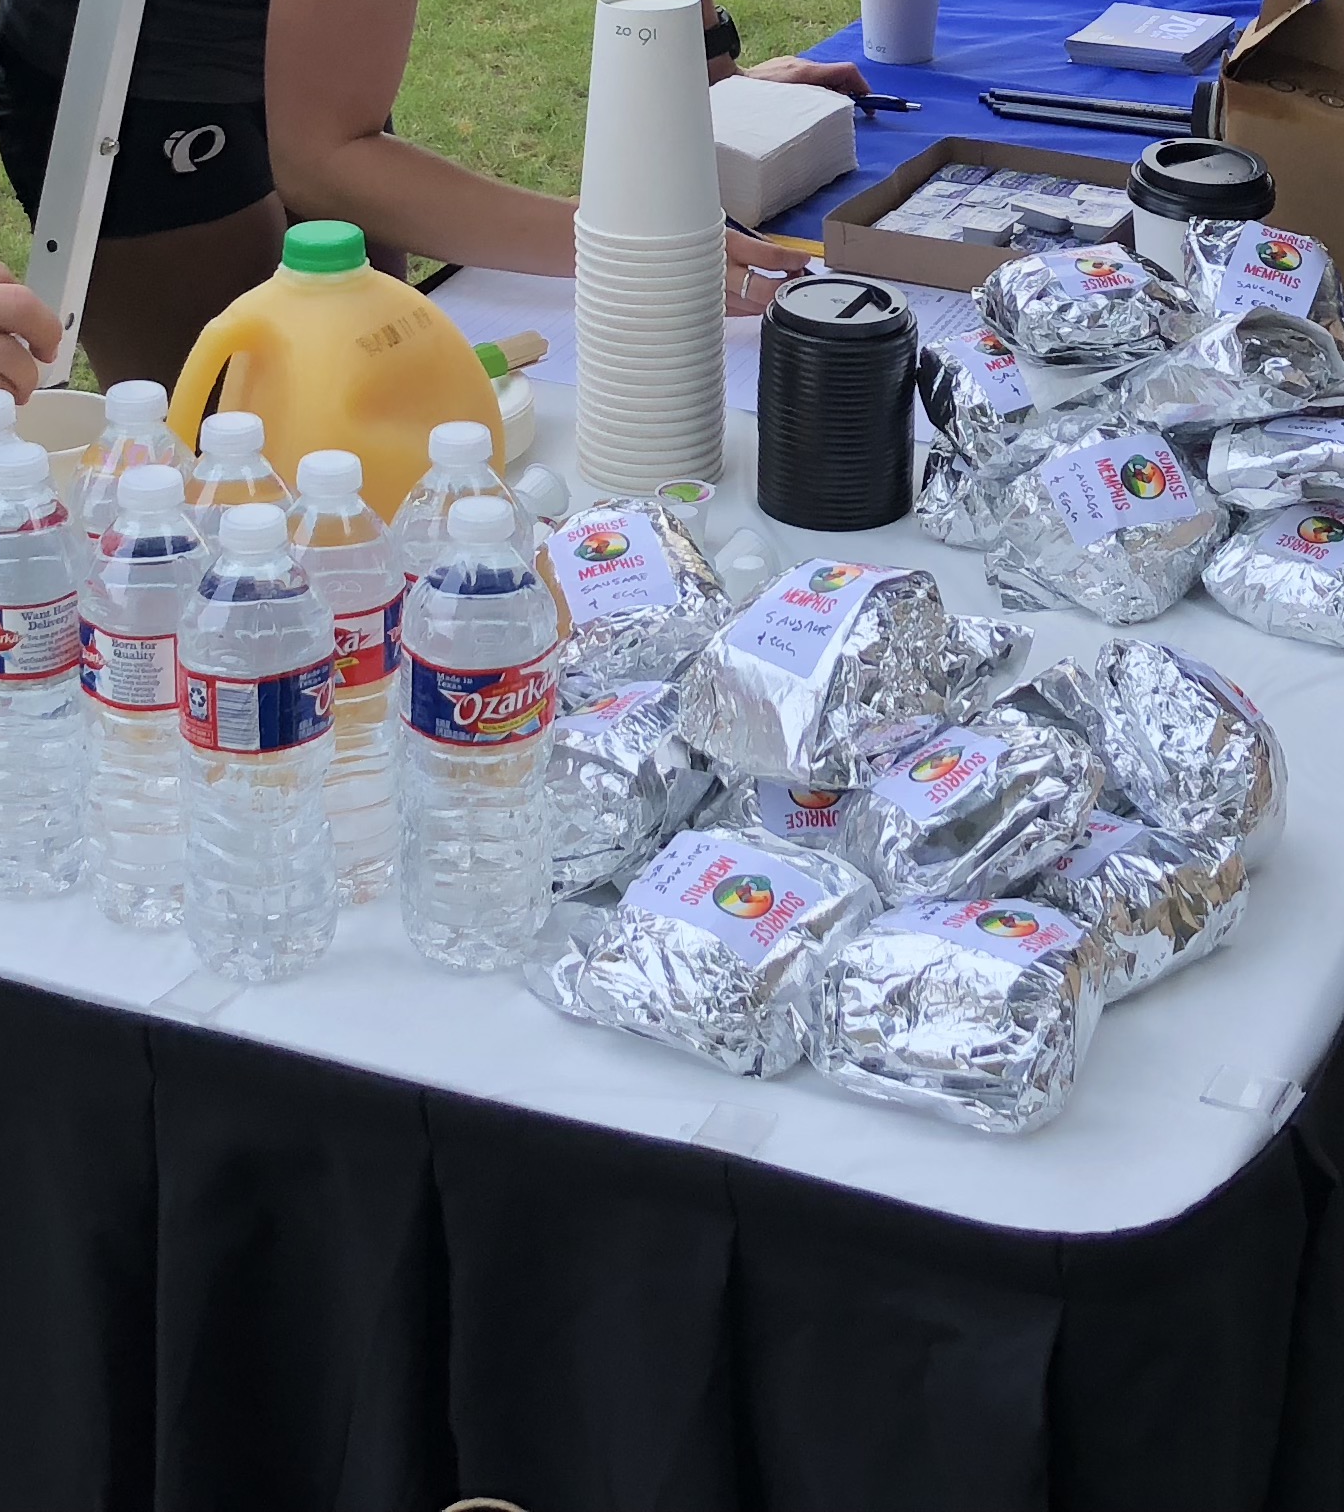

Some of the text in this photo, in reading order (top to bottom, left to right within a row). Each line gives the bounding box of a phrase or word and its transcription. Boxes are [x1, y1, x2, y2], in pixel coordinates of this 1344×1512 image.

[1260, 228, 1314, 253] SUNRISE
[1081, 273, 1135, 291] SUNRISE
[1243, 262, 1302, 290] MEMPHIS
[1094, 457, 1131, 512] MEMPHIS
[1154, 450, 1189, 501] SUNRISE
[1068, 462, 1104, 519] SAUSAGE
[566, 517, 629, 543] SUNRISE
[1276, 533, 1330, 560] SUNRISE
[577, 554, 645, 581] MEMPHIS
[21, 600, 78, 622] Want Home
[779, 588, 838, 614] MEMPHIS
[28, 610, 74, 631] Delivery?
[111, 638, 157, 651] Born for
[113, 649, 156, 662] Quality
[436, 672, 461, 684] Made
[436, 681, 463, 691] Texas
[924, 751, 988, 805] SUNRISE
[784, 809, 841, 829] UNRISE
[679, 854, 738, 906] MEMPHIS
[749, 890, 806, 947] SUNRISE
[1017, 922, 1070, 954] SUNRISE
